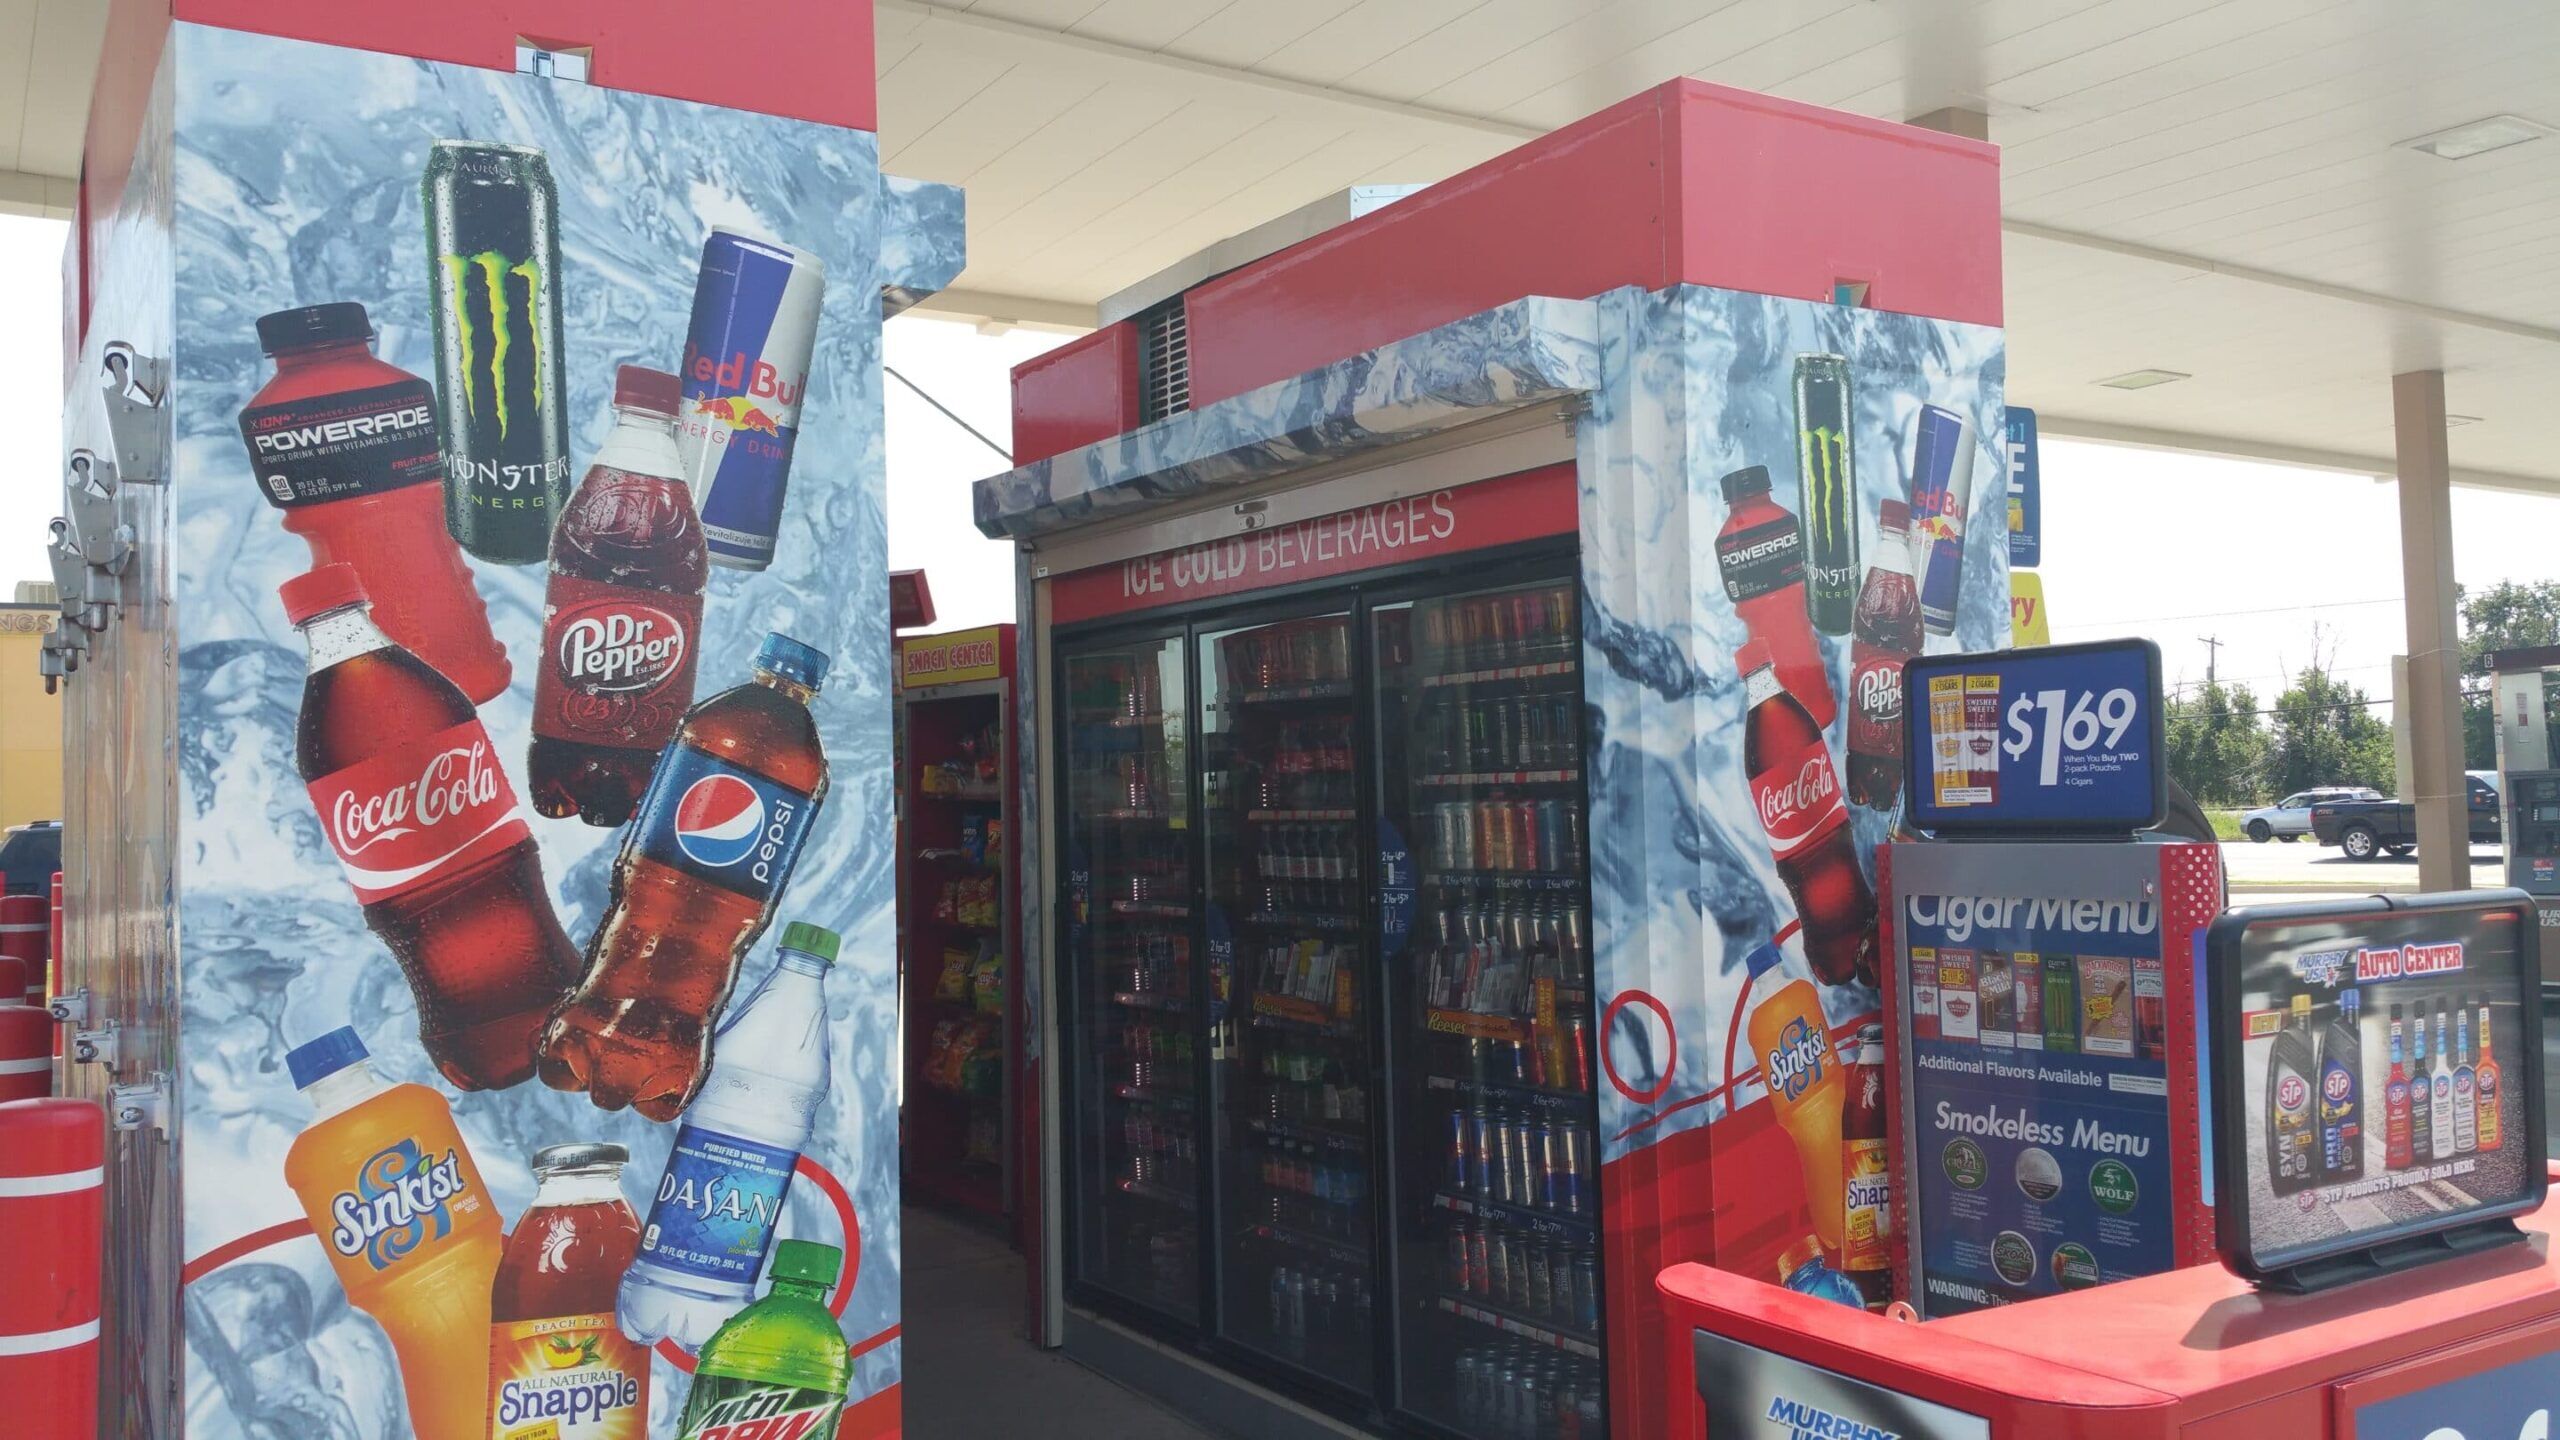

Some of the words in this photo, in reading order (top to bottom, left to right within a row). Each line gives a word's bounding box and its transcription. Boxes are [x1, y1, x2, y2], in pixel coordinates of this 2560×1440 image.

[750, 360, 807, 406] Bul
[255, 405, 431, 453] POWERADE
[680, 421, 739, 449] NERGY
[748, 440, 785, 459] DRIN
[262, 453, 287, 465] SPORTS
[288, 450, 315, 461] DRINK
[317, 445, 342, 457] WITH
[343, 435, 390, 451] VITAMINS
[391, 457, 417, 470] FRUIT
[440, 448, 569, 491] MONSTER
[1123, 551, 1164, 598] ICE
[1171, 534, 1247, 588] COLD
[1258, 489, 1456, 574] BEVERAGES
[1721, 532, 1799, 567] POWERADE
[0, 614, 52, 633] NGS
[607, 614, 653, 648] Dr
[561, 618, 678, 682] Pepper
[907, 645, 947, 675] SNACK
[950, 639, 995, 670] CENTER
[2485, 655, 2492, 668] 6
[1858, 670, 1902, 713] Peppe
[1976, 680, 1995, 688] CIGARS
[1966, 698, 1998, 706] SWISHER
[1967, 705, 1996, 713] SWEETS
[2063, 754, 2085, 764] When
[2086, 753, 2101, 764] You
[2101, 753, 2118, 765] Buy
[2118, 752, 2140, 762] TWO
[2064, 763, 2089, 774] 2-pack
[2089, 762, 2122, 772] Pouches
[1761, 754, 1833, 830] Coca-Cola
[2071, 777, 2094, 787] Cigars
[334, 741, 498, 856] Coca-Cola
[751, 799, 795, 884] pepsi
[1910, 895, 2023, 943] Cigar
[2025, 897, 2158, 935] Menu
[2538, 909, 2560, 918] MUR
[2296, 950, 2349, 970] MURPHY
[1980, 971, 2009, 987] Black
[2304, 966, 2328, 983] USA
[1990, 981, 2012, 994] Mild
[1768, 1028, 1827, 1092] Sunkist
[1918, 1054, 1984, 1075] Additional
[1986, 1061, 2036, 1081] Flavors
[2037, 1067, 2103, 1088] Available
[2281, 1080, 2302, 1104] STP
[2328, 1073, 2348, 1097] STP
[2414, 1085, 2426, 1099] STP
[2436, 1082, 2448, 1098] STP
[2457, 1077, 2470, 1091] STP
[2481, 1073, 2493, 1088] STP
[2392, 1088, 2404, 1103] STP
[1935, 1101, 2064, 1146] Smokeless
[2071, 1118, 2150, 1158] Menu
[703, 1142, 741, 1159] PURIFIED
[741, 1150, 767, 1164] WATER
[2278, 1134, 2292, 1177] SYN
[2094, 1185, 2135, 1201] WOLF
[2324, 1189, 2342, 1204] STP
[2344, 1176, 2391, 1199] PRODUCTS
[2391, 1168, 2430, 1188] PROUDLY
[2431, 1164, 2452, 1179] SOLD
[2453, 1159, 2476, 1175] HERE
[333, 1149, 464, 1255] Sunkist
[452, 1195, 477, 1213] ORANGE
[658, 1172, 782, 1229] DASANI
[1848, 1180, 1889, 1212] Snap
[2300, 1191, 2314, 1209] STP
[722, 1258, 735, 1268] 591
[1995, 1246, 2033, 1264] SKOAL
[1928, 1278, 1990, 1306] WARNING:
[534, 1318, 577, 1333] PEACH
[583, 1318, 607, 1327] TEA
[522, 1376, 547, 1391] ALL
[549, 1370, 616, 1387] NATURAL
[499, 1372, 639, 1426] Snapple
[705, 1391, 791, 1428] Mtn
[1768, 1396, 1895, 1440] MURPHY
